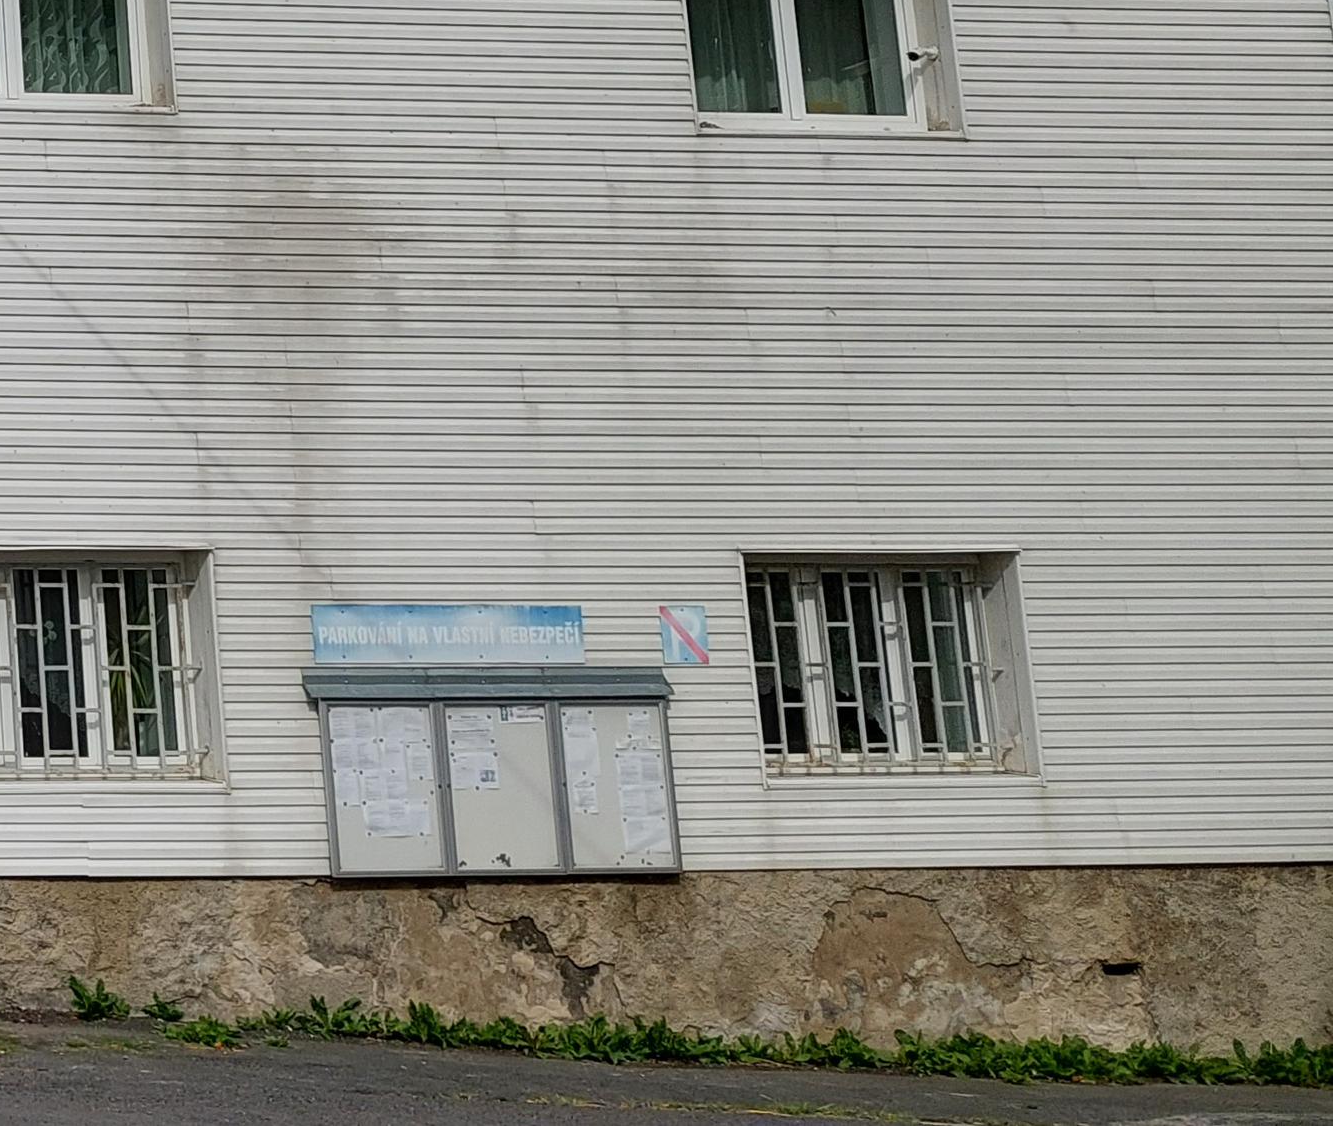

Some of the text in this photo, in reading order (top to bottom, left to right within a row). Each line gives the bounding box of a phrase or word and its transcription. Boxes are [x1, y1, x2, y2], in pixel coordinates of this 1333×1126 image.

[318, 620, 582, 646] PARKOVÁNÍ NA VLASTNÍ NEBEZPEČÍ
